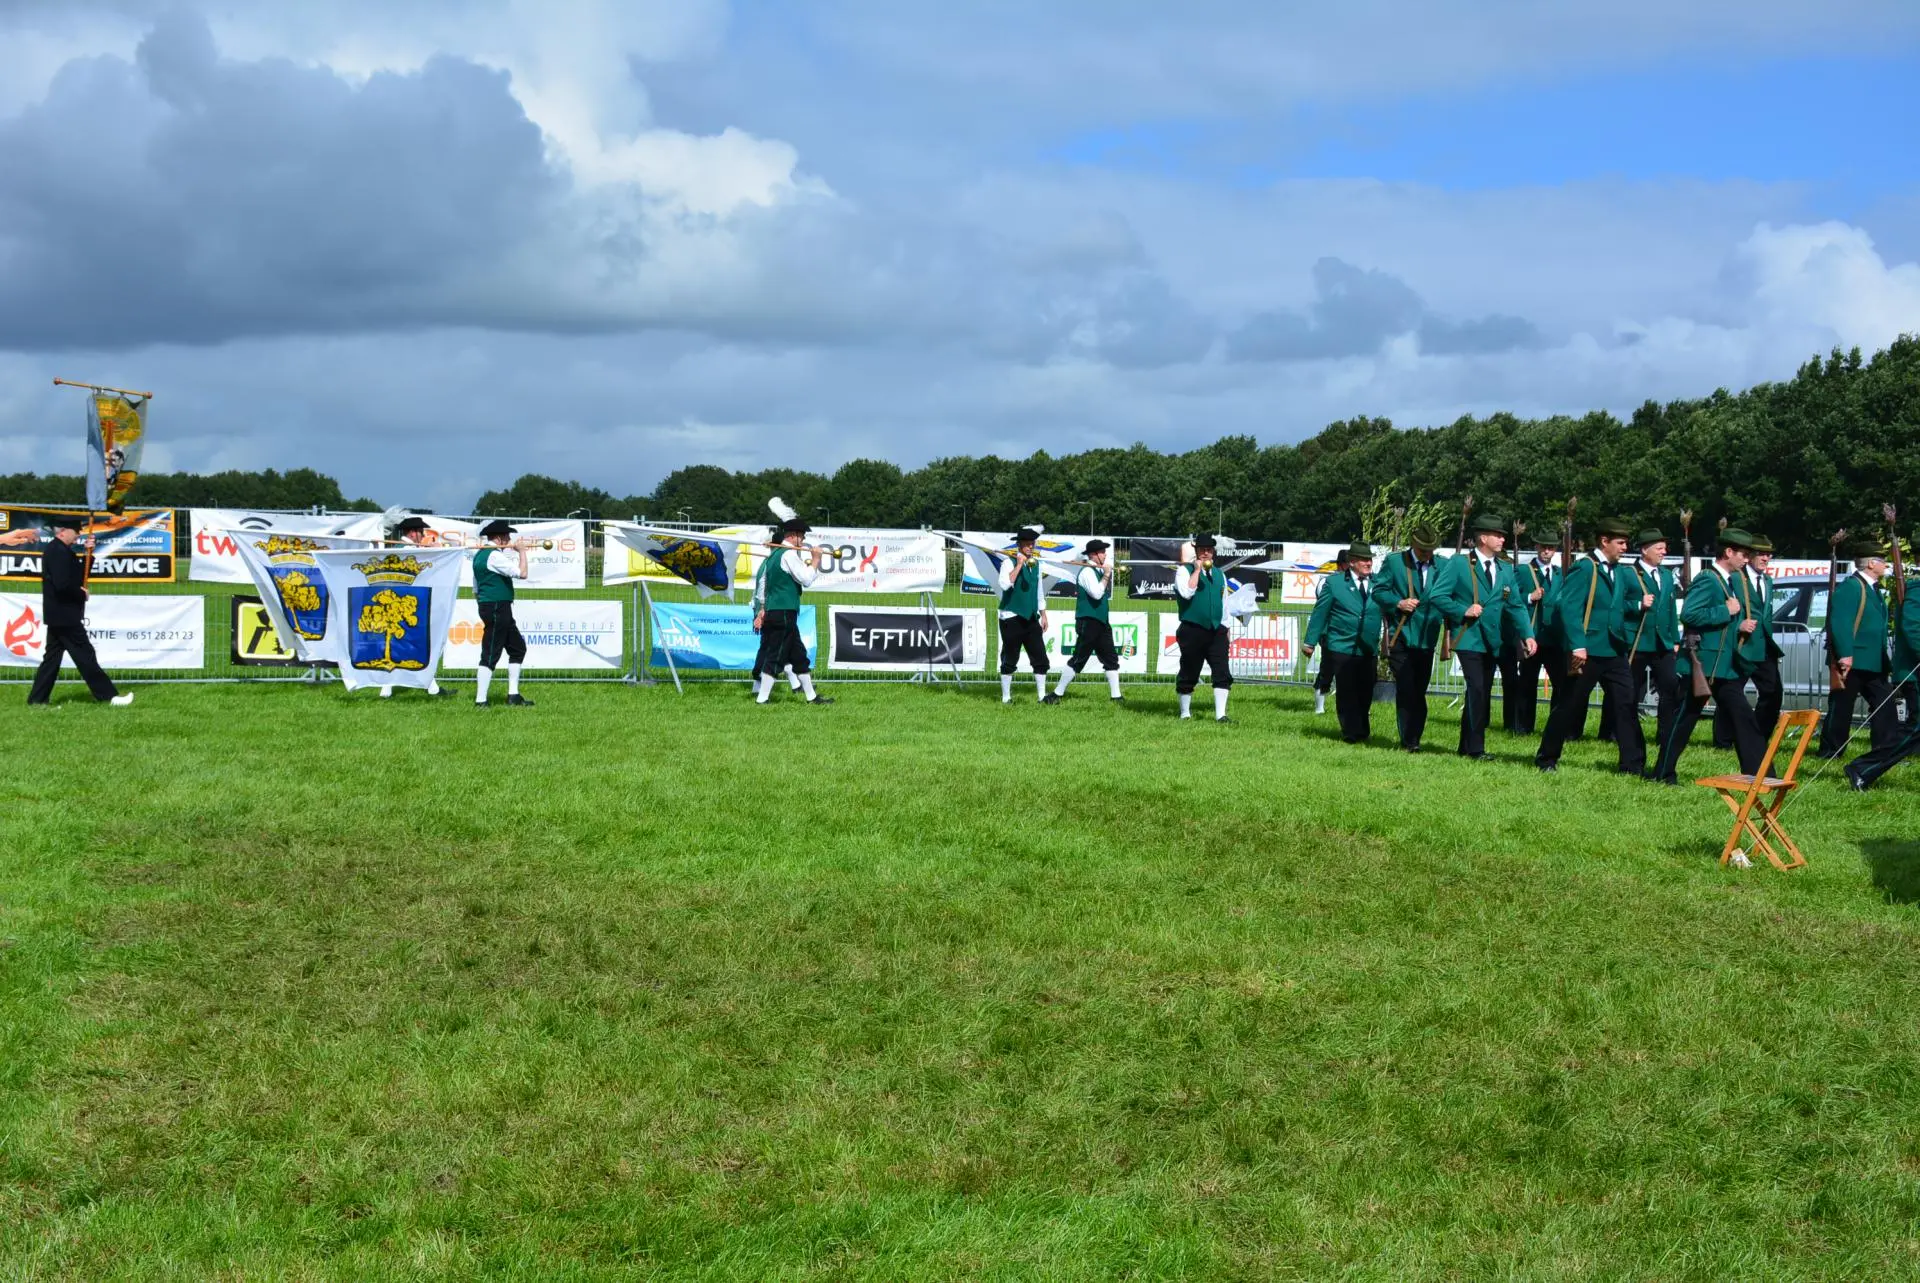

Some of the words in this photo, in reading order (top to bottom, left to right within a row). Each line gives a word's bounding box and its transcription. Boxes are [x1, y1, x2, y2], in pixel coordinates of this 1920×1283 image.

[194, 529, 239, 556] tw
[90, 557, 160, 574] ERVICE
[522, 622, 615, 630] UWBEDRIJF
[86, 630, 116, 640] NTIE
[126, 632, 139, 640] 06
[141, 632, 152, 640] 51
[154, 631, 166, 640] 28
[169, 631, 180, 640] 21
[182, 631, 194, 640] 23
[521, 634, 582, 645] MMERSEN
[585, 635, 600, 645] BV
[851, 628, 949, 650] EFFTINK
[657, 635, 701, 649] ALMAX
[1229, 644, 1286, 657] issink
